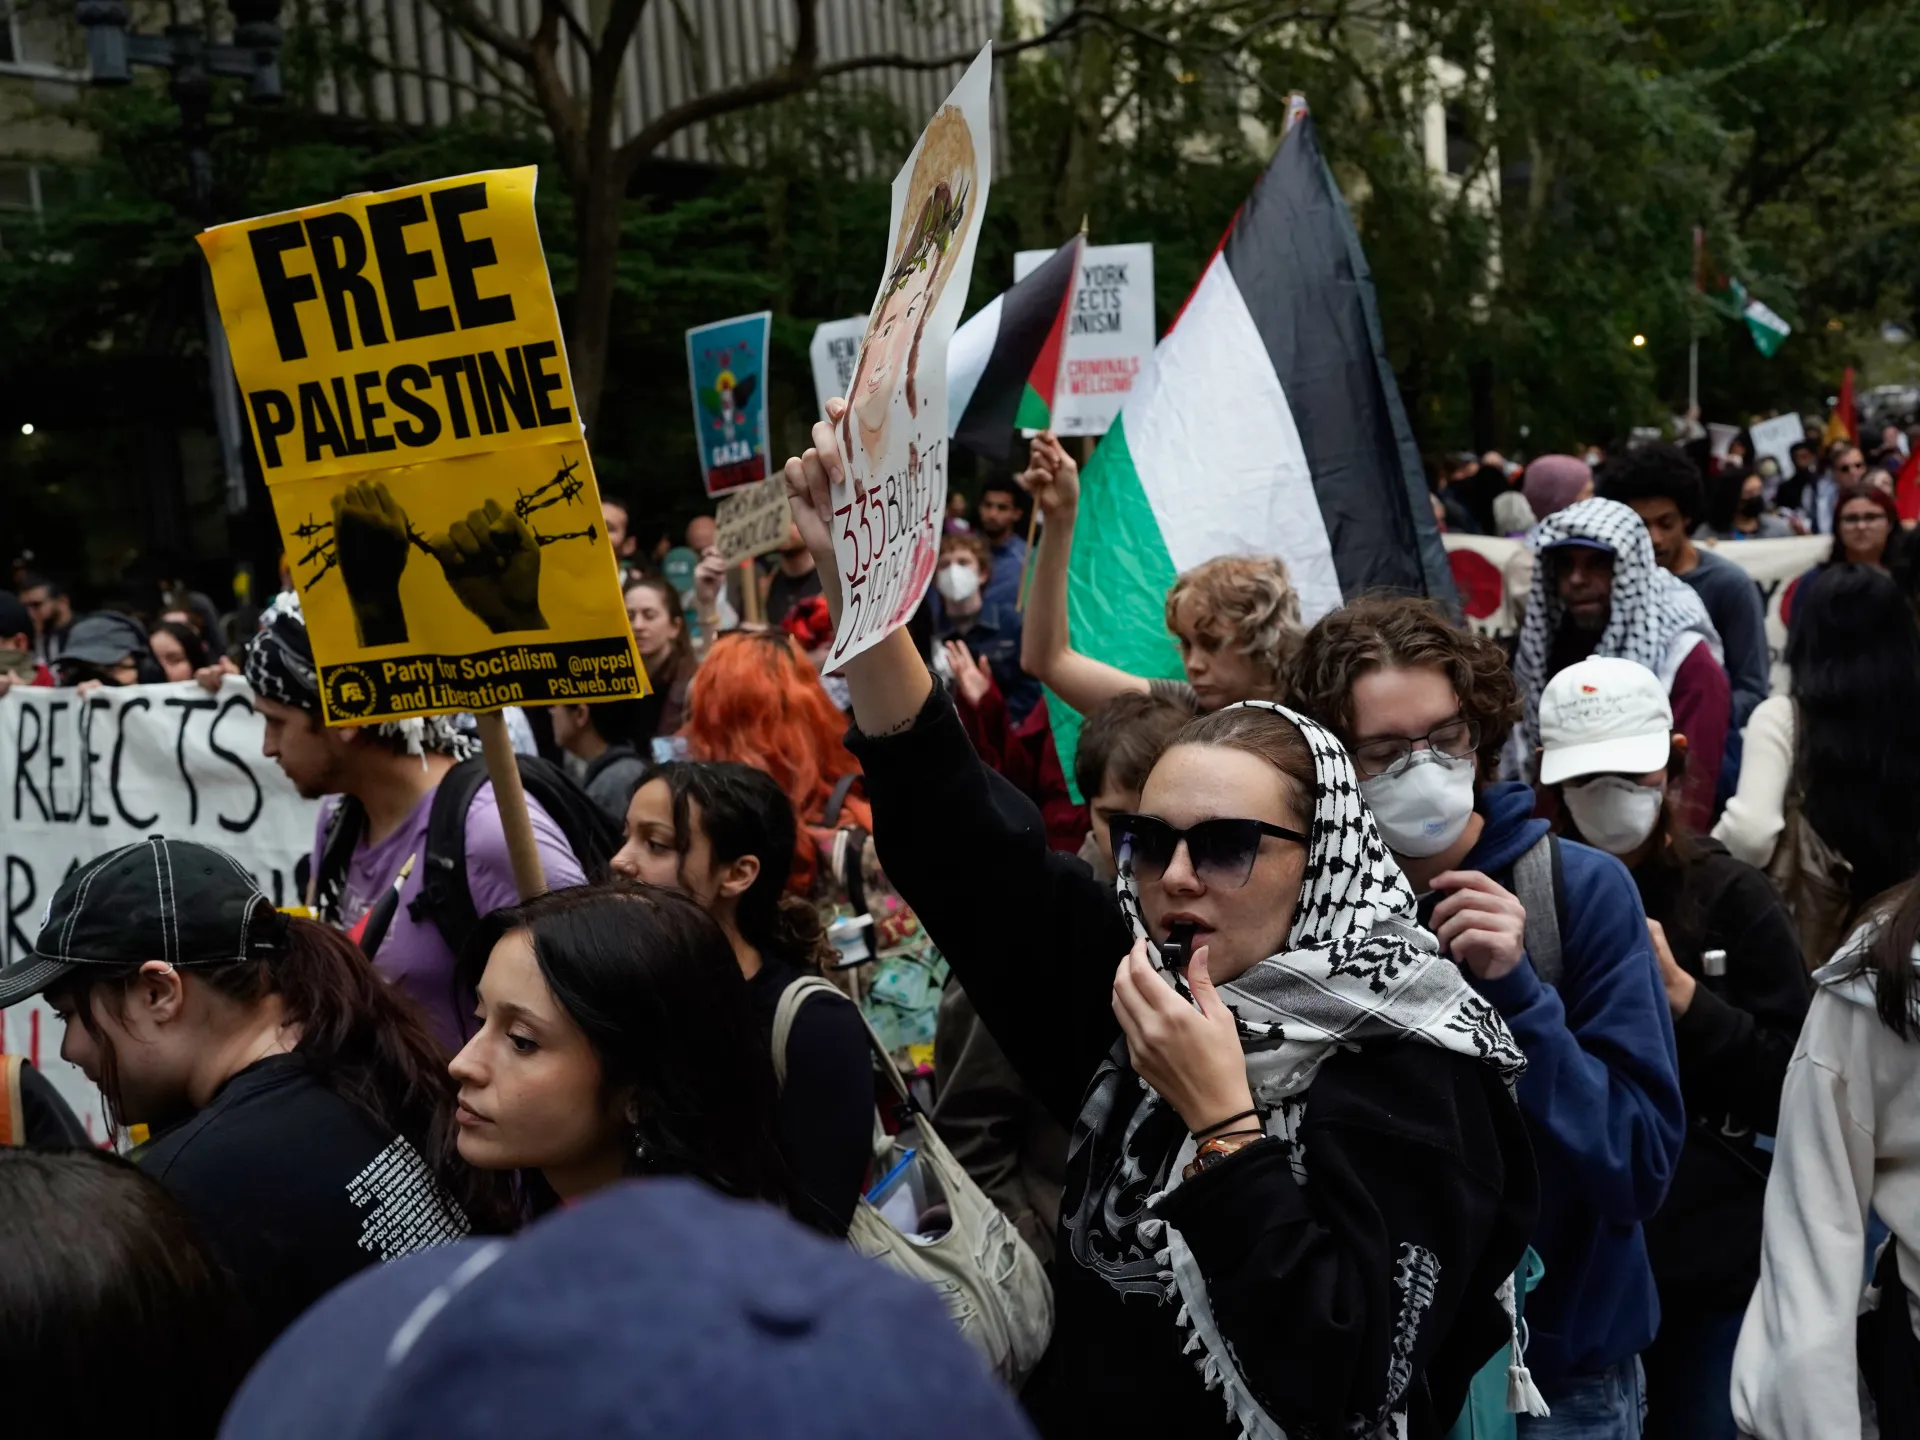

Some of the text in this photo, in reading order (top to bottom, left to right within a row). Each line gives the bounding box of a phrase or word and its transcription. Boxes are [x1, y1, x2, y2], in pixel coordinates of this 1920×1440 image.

[248, 182, 516, 361] FREE
[1082, 263, 1129, 286] YORK
[1068, 357, 1139, 376] CRIMINALS
[249, 340, 572, 468] PALESTINE
[834, 485, 886, 584] 335
[834, 574, 867, 661] 5
[382, 647, 558, 685] Party for Socialism
[568, 648, 633, 677] @nycpsl
[390, 682, 524, 712] and Liberation
[547, 674, 639, 697] PSLweb.org
[14, 694, 263, 833] REJECTS
[345, 1175, 364, 1192] THIS
[360, 1169, 370, 1179] IS
[366, 1161, 377, 1173] AN
[374, 1147, 391, 1165] OBEY
[349, 1186, 364, 1203] ARE
[362, 1162, 390, 1189] THINKING
[388, 1146, 405, 1165] ABOUT
[355, 1191, 372, 1208] YOU
[369, 1183, 381, 1195] TO
[378, 1158, 406, 1187] CONSIDER
[361, 1218, 369, 1230] IF
[368, 1205, 384, 1221] YOU
[383, 1193, 397, 1209] ARE
[376, 1190, 387, 1201] TO
[357, 1215, 387, 1248] PEOPLES
[365, 1240, 374, 1252] IF
[372, 1226, 389, 1243] YOU
[387, 1192, 422, 1230] PARTICIPATE
[379, 1239, 387, 1250] IF
[386, 1225, 403, 1242] YOU
[400, 1210, 417, 1228] TURN
[380, 1251, 388, 1262] IF
[387, 1236, 403, 1254] YOU
[402, 1224, 417, 1241] ARE
[396, 1234, 418, 1260] ABUSE
